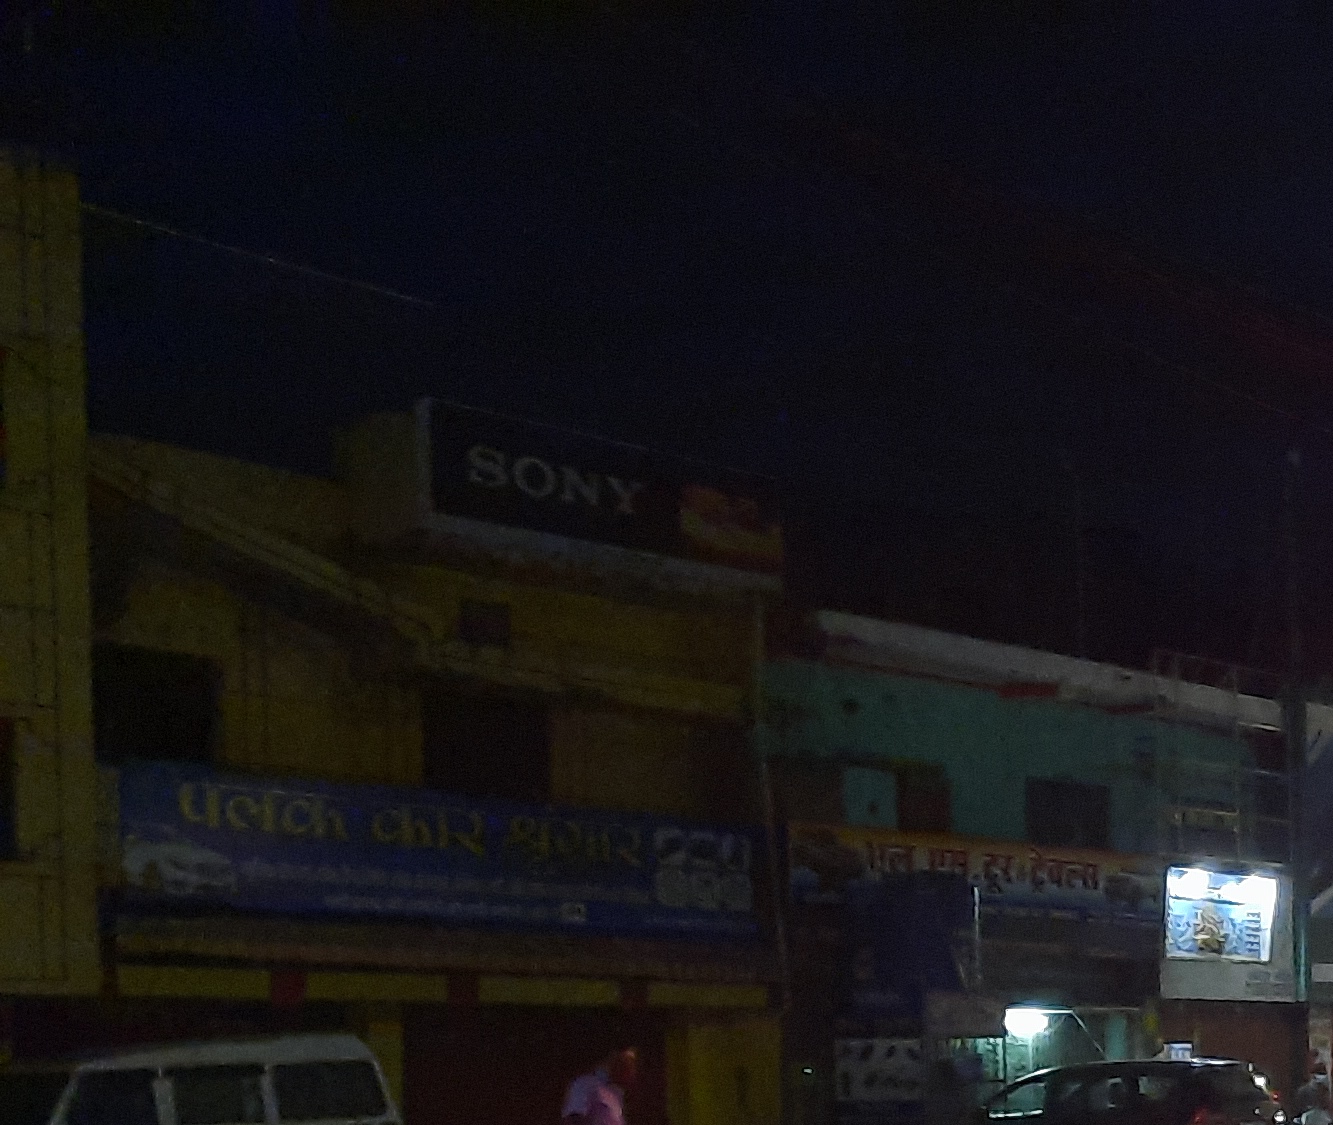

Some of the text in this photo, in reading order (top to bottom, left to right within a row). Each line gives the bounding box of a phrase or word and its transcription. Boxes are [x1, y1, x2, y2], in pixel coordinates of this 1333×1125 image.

[466, 443, 647, 515] SONY
[177, 781, 350, 842] पलक
[370, 799, 487, 858] कार
